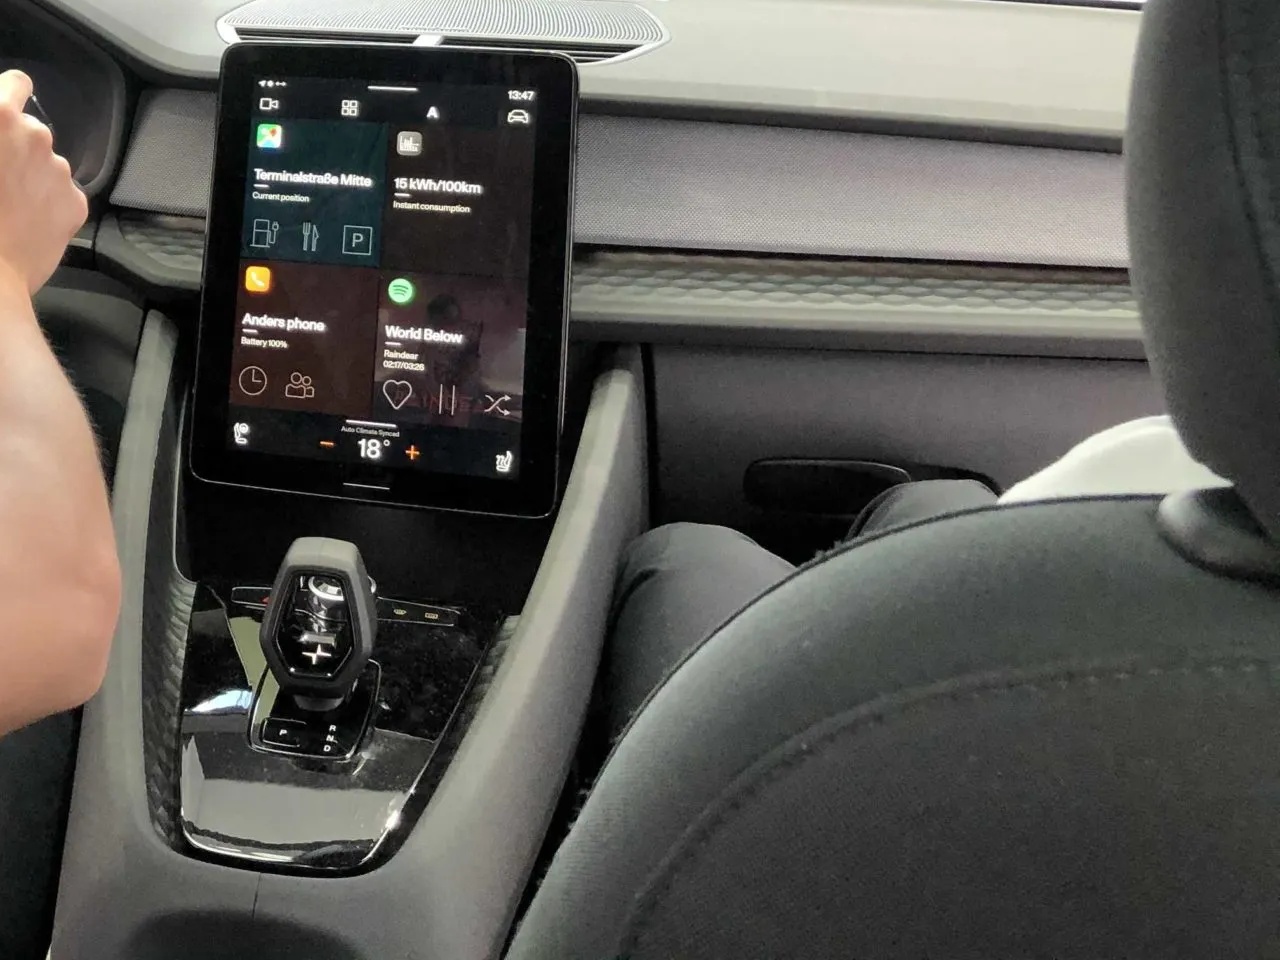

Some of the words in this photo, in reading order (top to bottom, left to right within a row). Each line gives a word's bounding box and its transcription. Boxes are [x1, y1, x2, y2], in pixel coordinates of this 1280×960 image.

[508, 90, 535, 100] 13:47
[253, 168, 339, 185] Terminalstraße
[340, 173, 373, 187] Mitte
[394, 177, 408, 189] 15
[409, 178, 483, 194] kWh/100km
[252, 191, 280, 201] Current
[280, 194, 310, 202] position
[393, 201, 420, 210] Instant
[420, 203, 471, 213] consumption
[242, 312, 285, 328] Anders
[286, 317, 326, 331] phone
[385, 325, 422, 340] World
[423, 328, 463, 343] Below
[241, 336, 268, 348] Battery
[268, 339, 288, 349] 100%
[384, 349, 419, 360] Raindear
[356, 427, 378, 435] Climate
[378, 429, 400, 438] Synced
[323, 744, 331, 752] D
